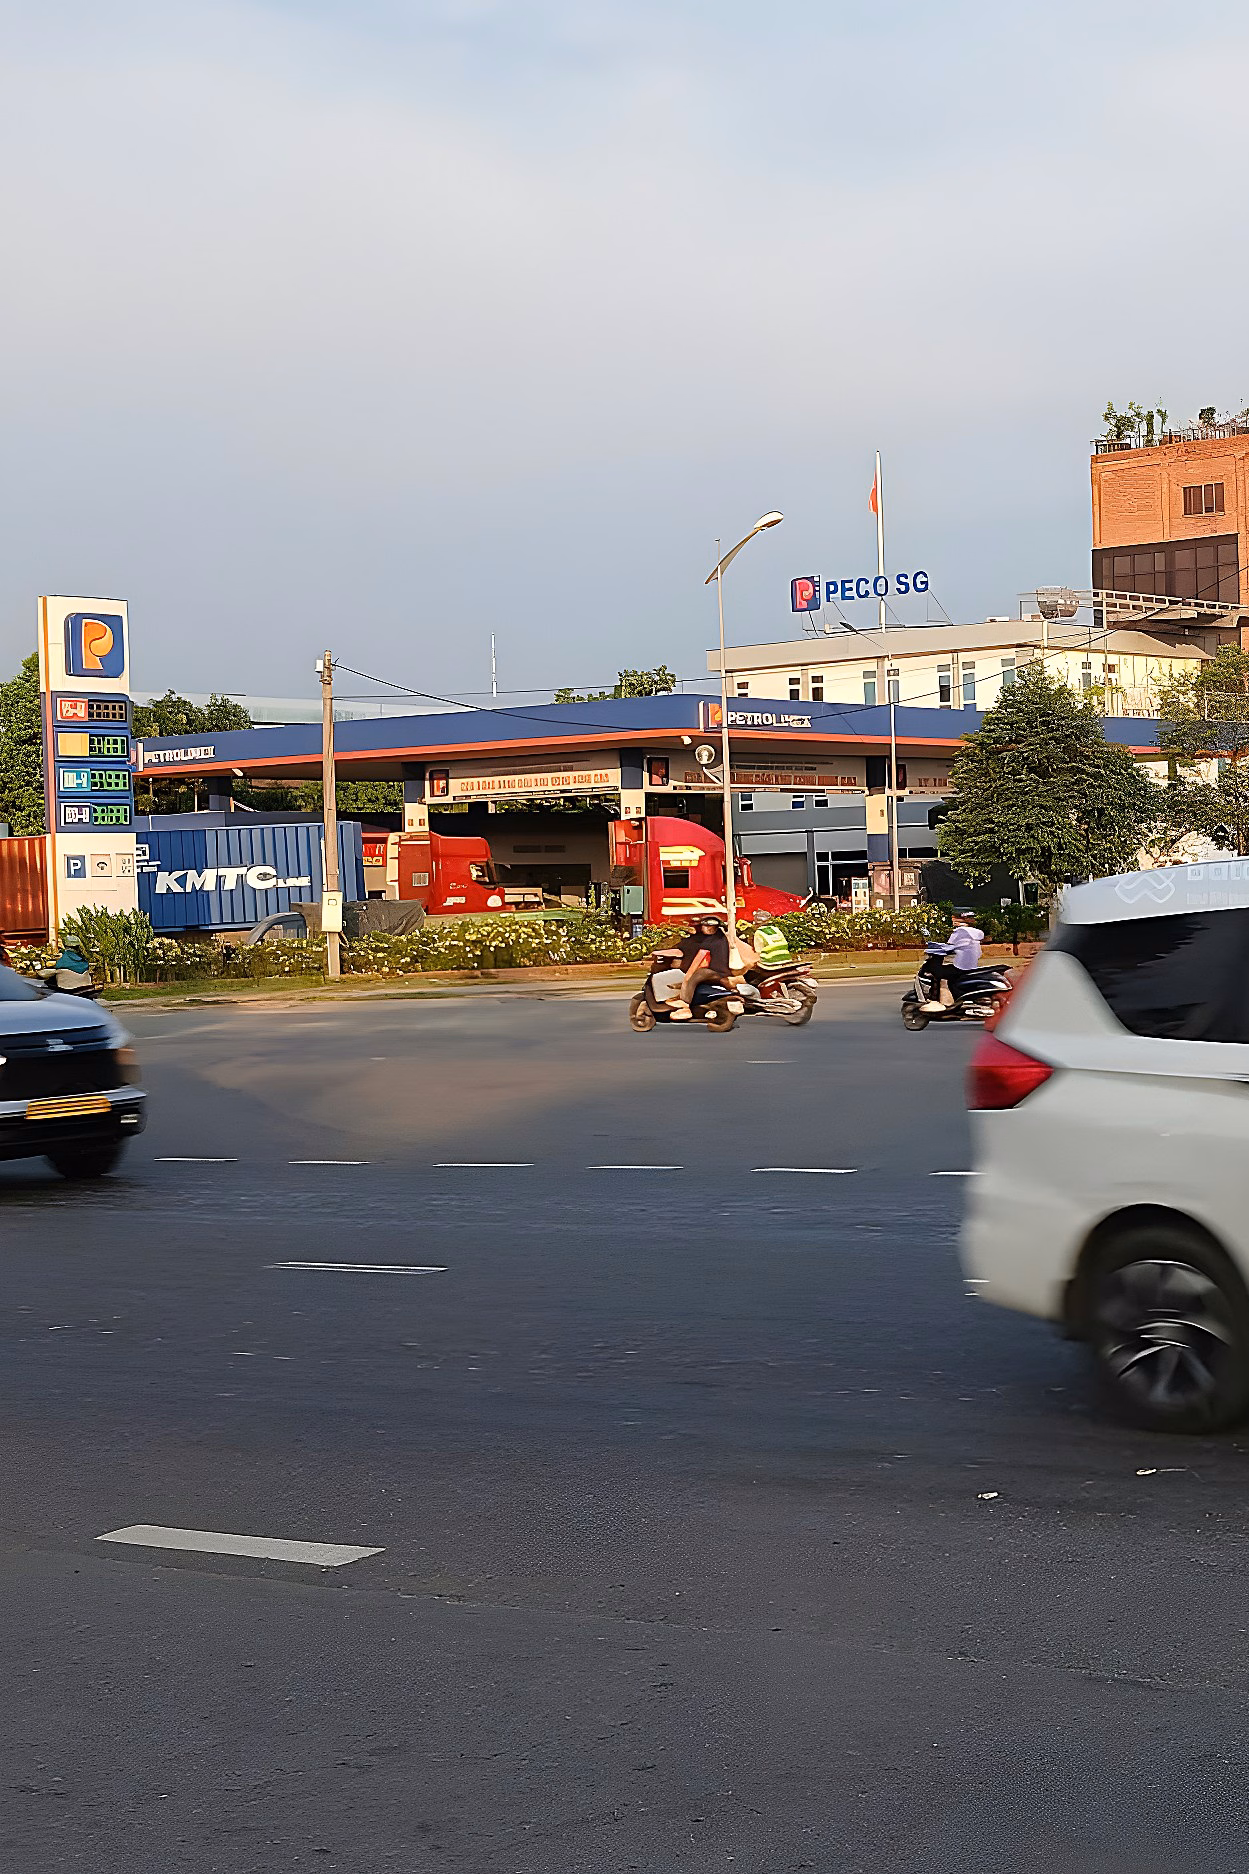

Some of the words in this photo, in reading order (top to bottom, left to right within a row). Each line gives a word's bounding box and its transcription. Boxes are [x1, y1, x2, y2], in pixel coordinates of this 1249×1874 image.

[825, 575, 889, 603] PECO
[895, 570, 929, 595] SG
[155, 865, 278, 894] KMTC
